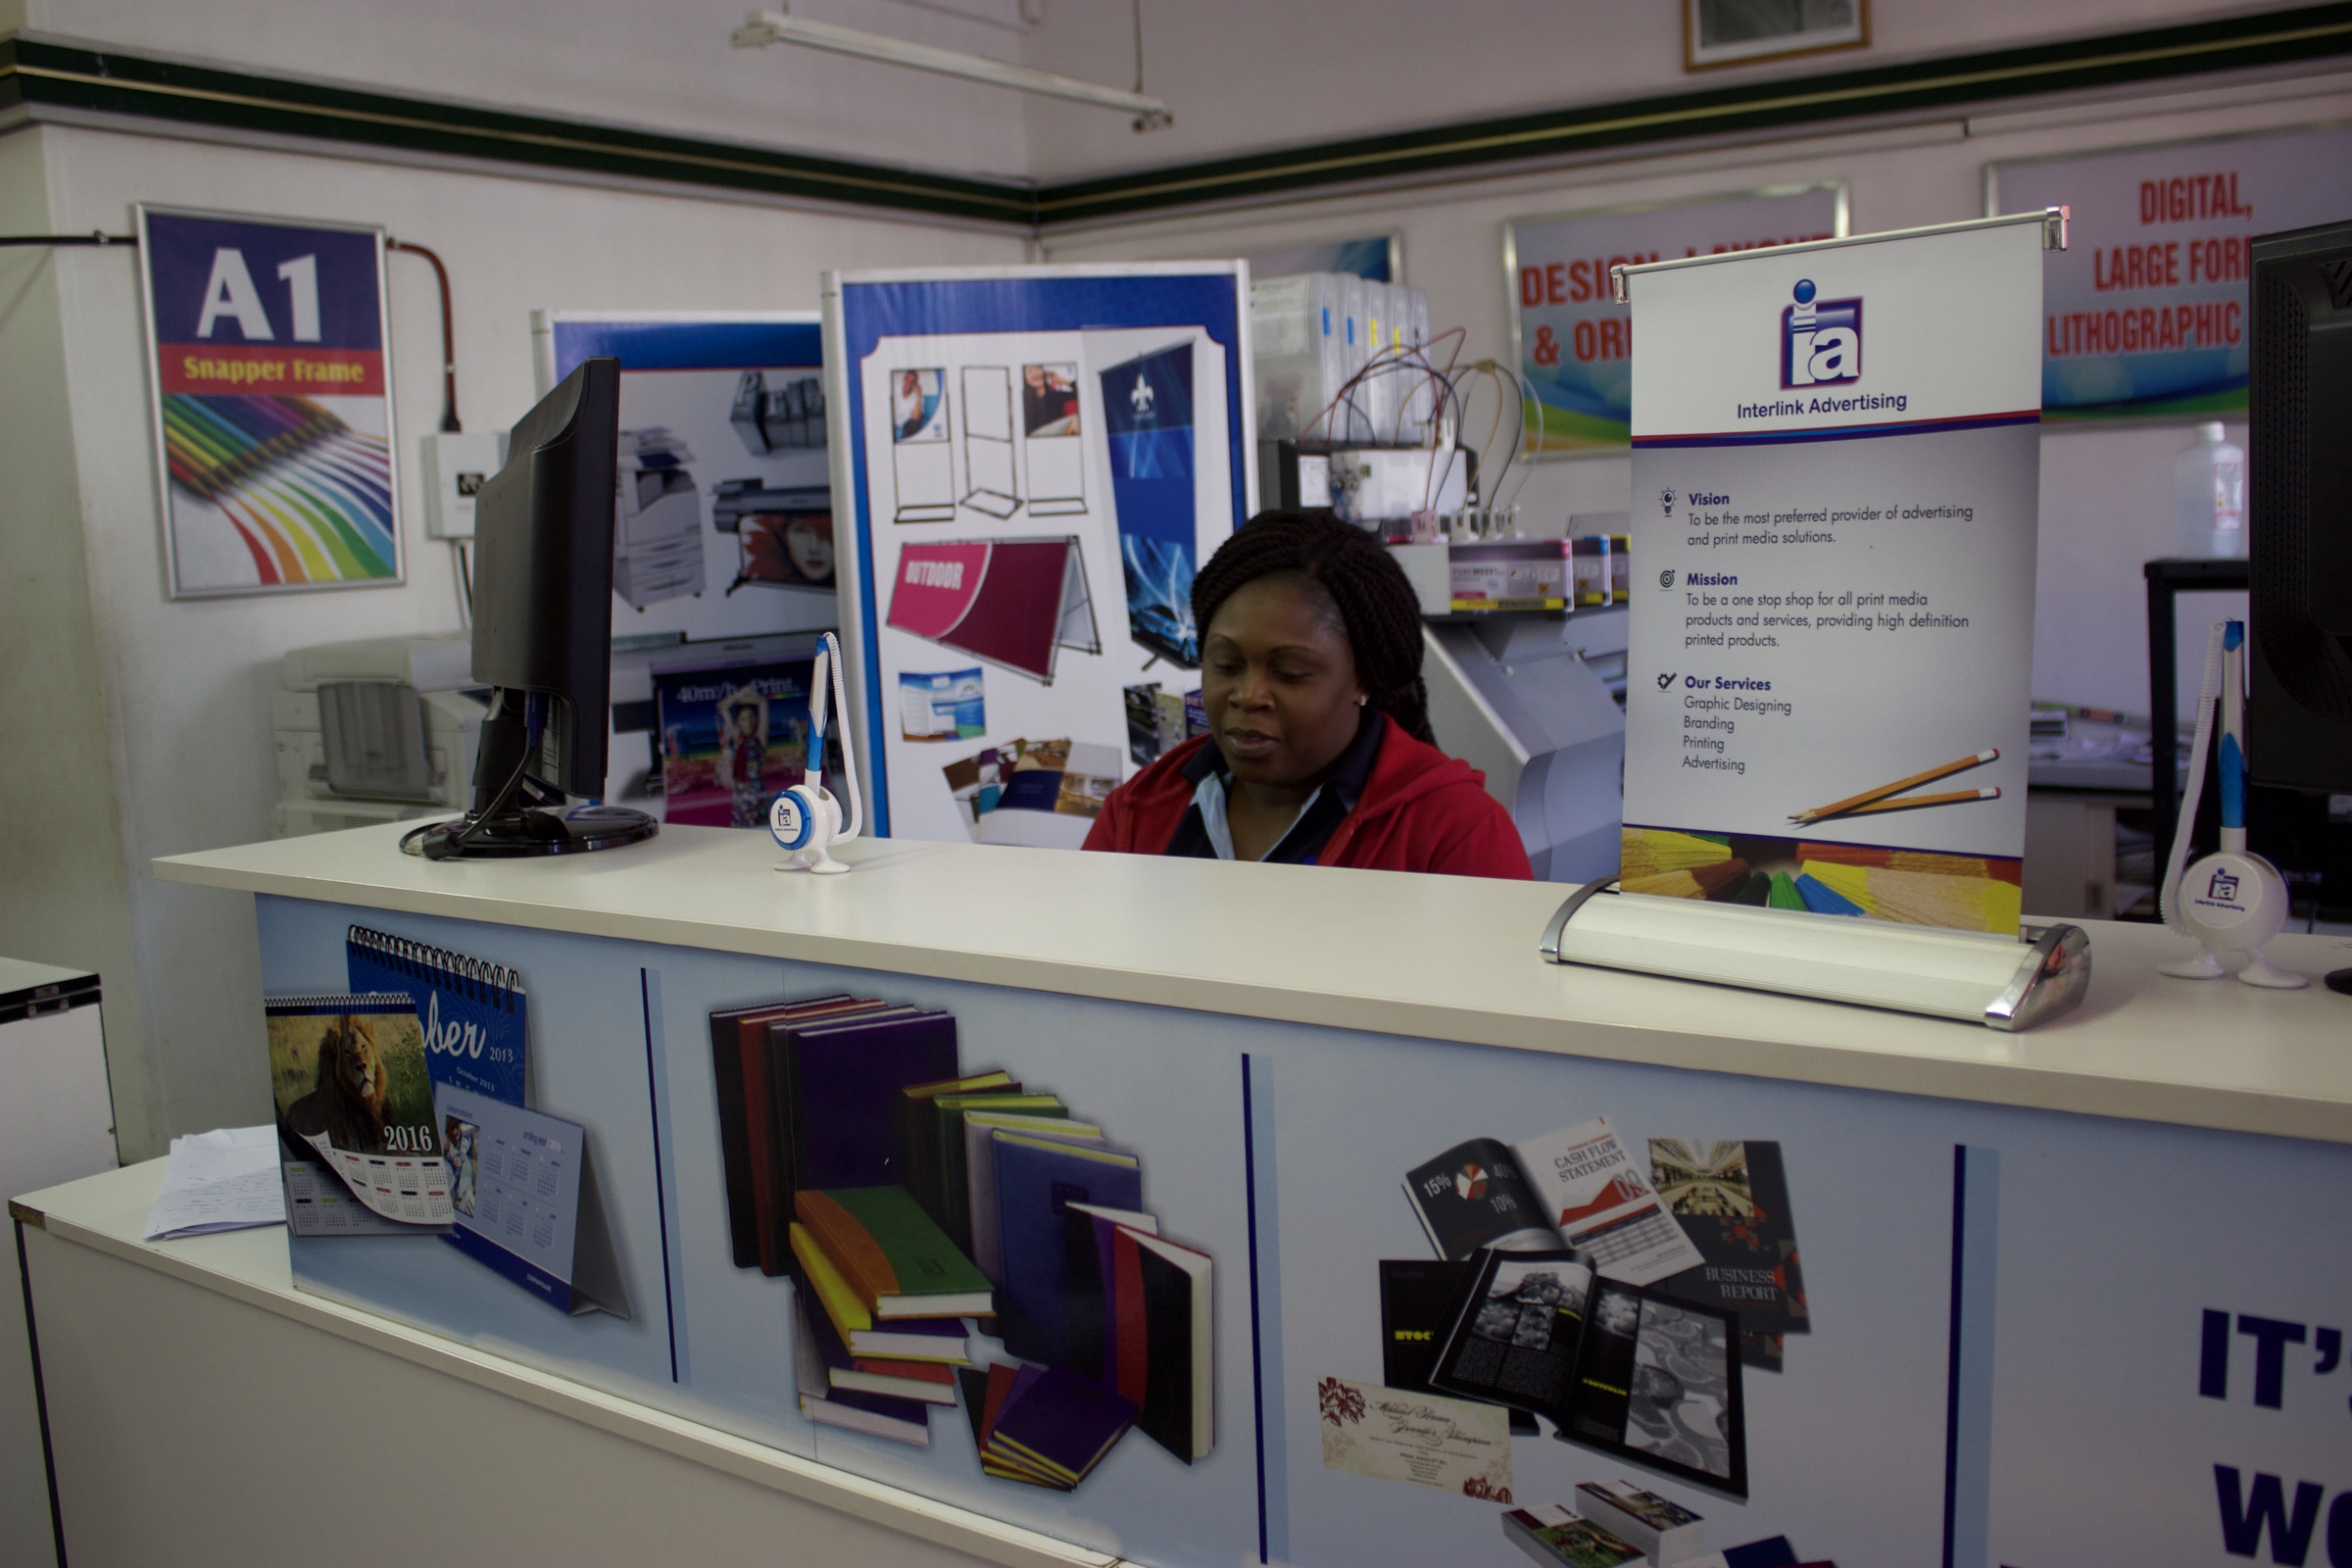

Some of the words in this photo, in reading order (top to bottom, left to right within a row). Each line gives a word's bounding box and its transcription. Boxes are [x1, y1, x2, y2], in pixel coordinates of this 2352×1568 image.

[2140, 172, 2252, 225] DIGITAL,
[2094, 241, 2180, 292] LARGE
[2189, 235, 2250, 283] FOR
[196, 247, 322, 343] A1
[2048, 301, 2244, 358] LITHOGRAPHIC
[1534, 324, 1561, 368] &
[184, 355, 285, 383] Snapper
[294, 359, 364, 383] Frame
[1738, 400, 1804, 419] Interlink
[1809, 393, 1907, 413] Advertising
[1689, 493, 1730, 506] Vision
[1689, 514, 1701, 526] To
[1704, 513, 1718, 525] be
[1722, 512, 1740, 525] the
[1744, 513, 1770, 524] most
[1775, 509, 1827, 527] preferred
[1832, 507, 1882, 525] provider
[1886, 506, 1898, 519] of
[1902, 505, 1973, 522] advertising
[1688, 532, 1709, 546] and
[1714, 532, 1738, 549] print
[1742, 531, 1778, 545] media
[1783, 530, 1836, 544] solutions.
[905, 560, 964, 590] OUTDOOR
[1687, 573, 1738, 586] Mission
[1687, 593, 1699, 606] To
[1702, 592, 1717, 606] be
[1720, 596, 1728, 606] a
[1732, 596, 1753, 606] one
[1758, 594, 1782, 609] stop
[1786, 592, 1814, 609] shop
[1818, 591, 1834, 606] for
[1838, 591, 1852, 606] all
[1857, 593, 1885, 609] print
[1888, 591, 1928, 606] media
[1686, 613, 1733, 628] products
[1737, 613, 1759, 626] and
[1763, 614, 1812, 628] services,
[1817, 613, 1873, 630] providing
[1878, 613, 1904, 630] high
[1909, 612, 1969, 628] definition
[1686, 634, 1724, 649] printed
[1728, 634, 1780, 649] products.
[1685, 675, 1710, 689] Our
[1715, 676, 1772, 692] Services
[1685, 696, 1730, 712] Graphic
[1734, 697, 1791, 716] Designing
[1684, 715, 1735, 734] Branding
[1683, 735, 1725, 753] Printing
[1683, 756, 1745, 774] Advertising
[490, 1046, 514, 1063] 2013
[479, 1078, 495, 1093] 2013
[384, 1125, 432, 1152] 2016
[1554, 1150, 1589, 1169] CASH
[1591, 1139, 1618, 1158] FLOW
[1558, 1150, 1627, 1183] STATEMENT
[1423, 1173, 1452, 1198] 15%
[1490, 1194, 1518, 1213] 10%
[1706, 1267, 1776, 1284] BUSINESS
[1720, 1284, 1778, 1300] REPORT
